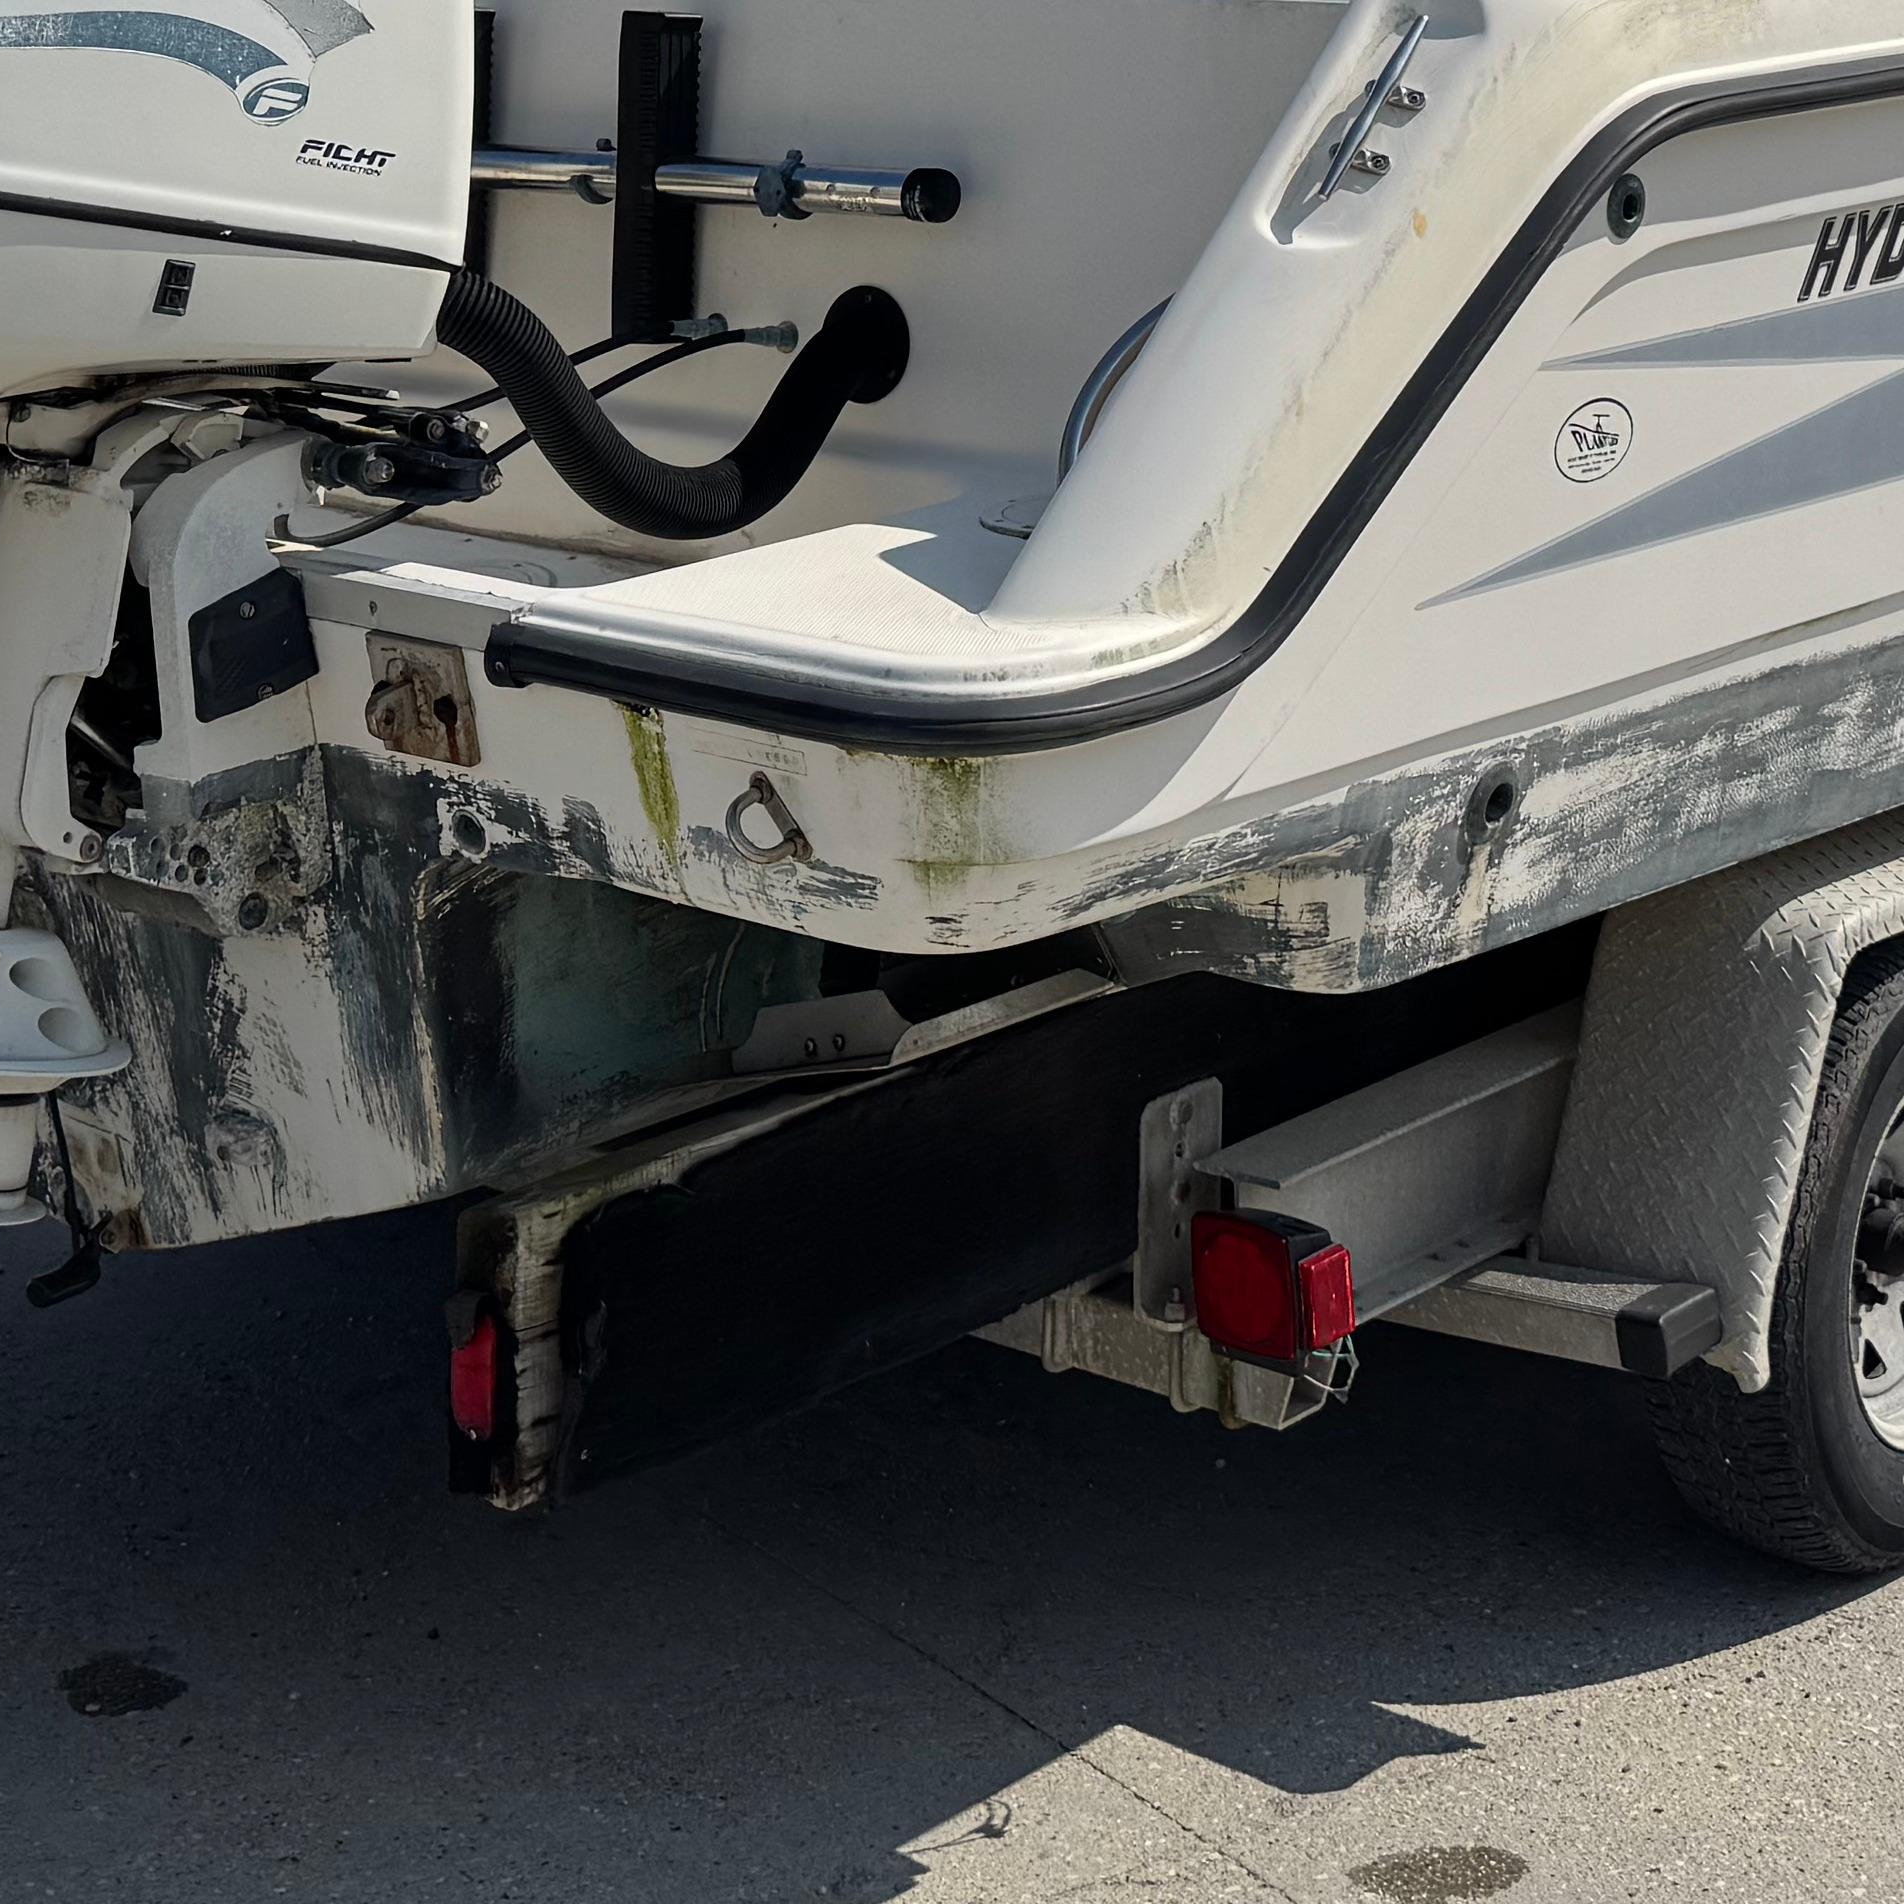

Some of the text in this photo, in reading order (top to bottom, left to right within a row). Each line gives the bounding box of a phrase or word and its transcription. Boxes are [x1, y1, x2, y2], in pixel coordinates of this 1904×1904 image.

[300, 139, 397, 168] FICHT
[296, 156, 382, 177] FUEL INJECTION
